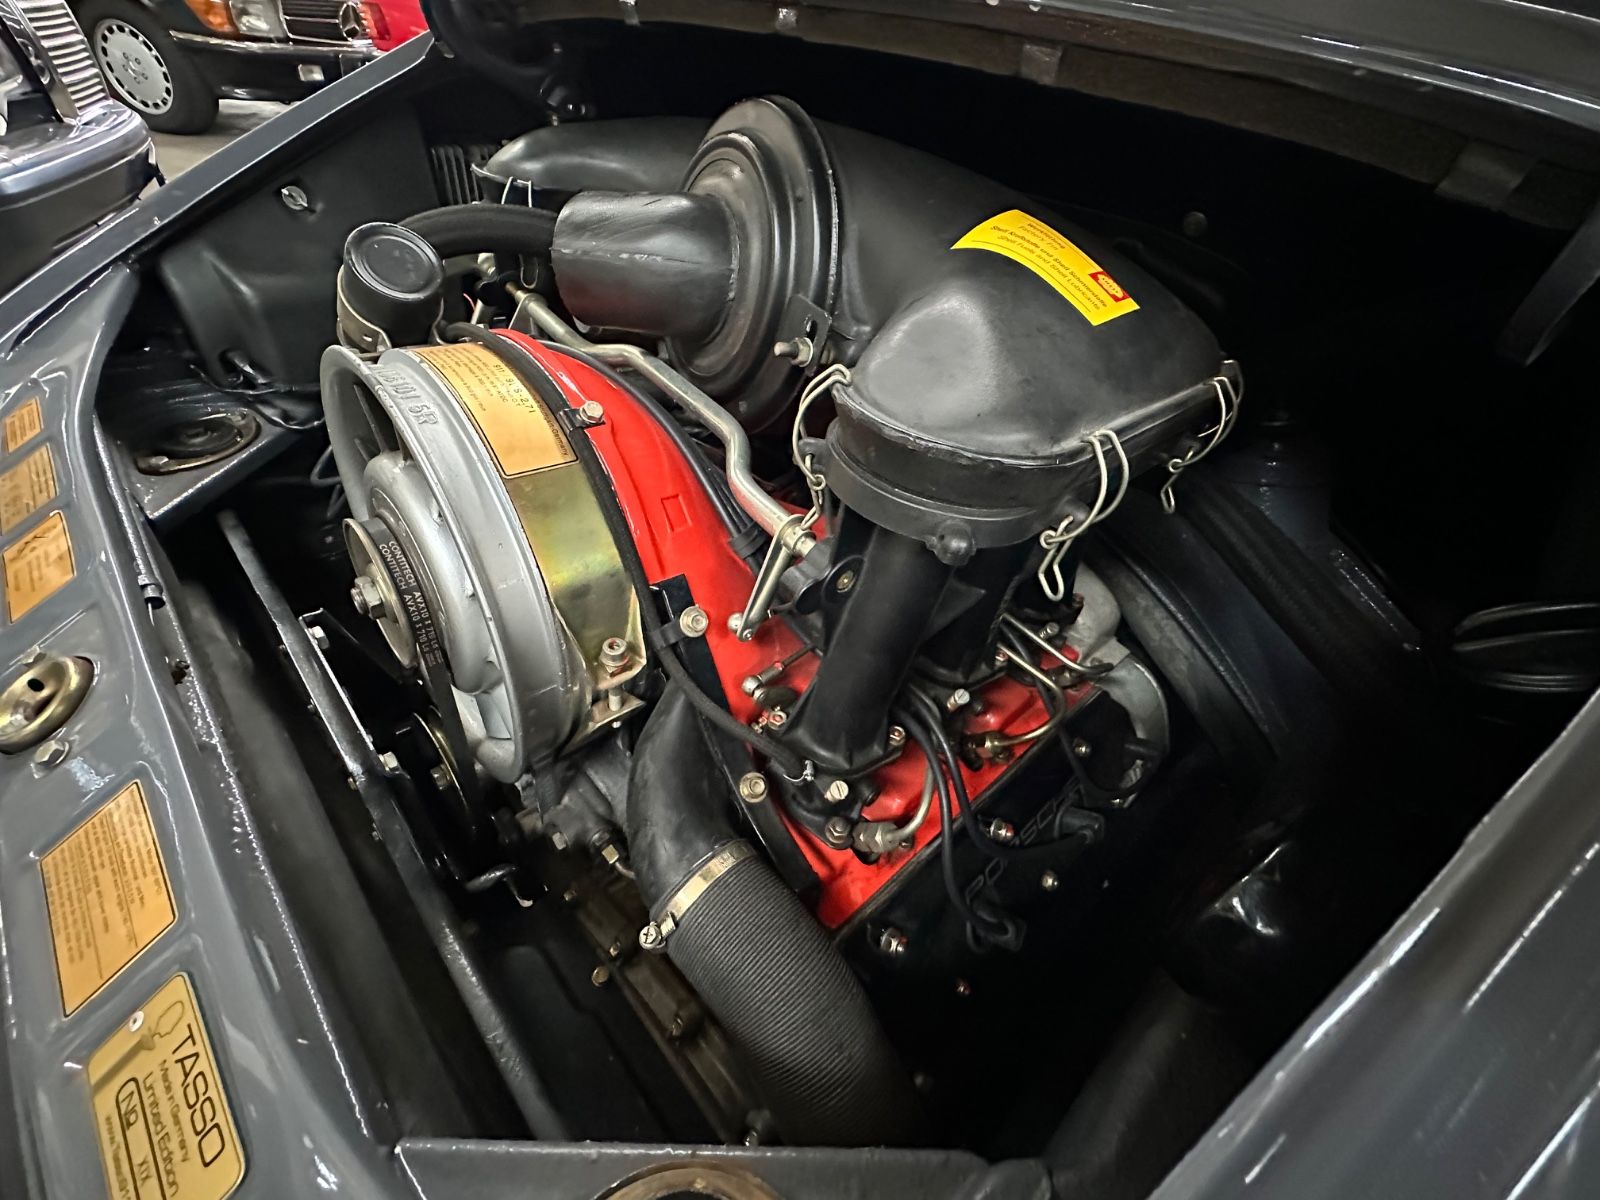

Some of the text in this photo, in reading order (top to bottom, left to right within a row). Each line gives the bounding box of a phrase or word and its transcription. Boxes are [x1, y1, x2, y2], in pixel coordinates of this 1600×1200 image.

[990, 225, 1009, 233] Shell
[1053, 258, 1070, 271] Shell
[1035, 253, 1050, 265] and
[1050, 263, 1067, 279] Shell
[379, 543, 407, 591] CONTITECH
[403, 594, 421, 621] AVX10
[389, 540, 417, 587] CONTITECH
[413, 591, 430, 618] AVX10
[142, 1071, 180, 1198] Limited Edition
[158, 1059, 173, 1098] Made
[169, 1102, 191, 1164] Germany
[172, 1023, 225, 1168] TASSO
